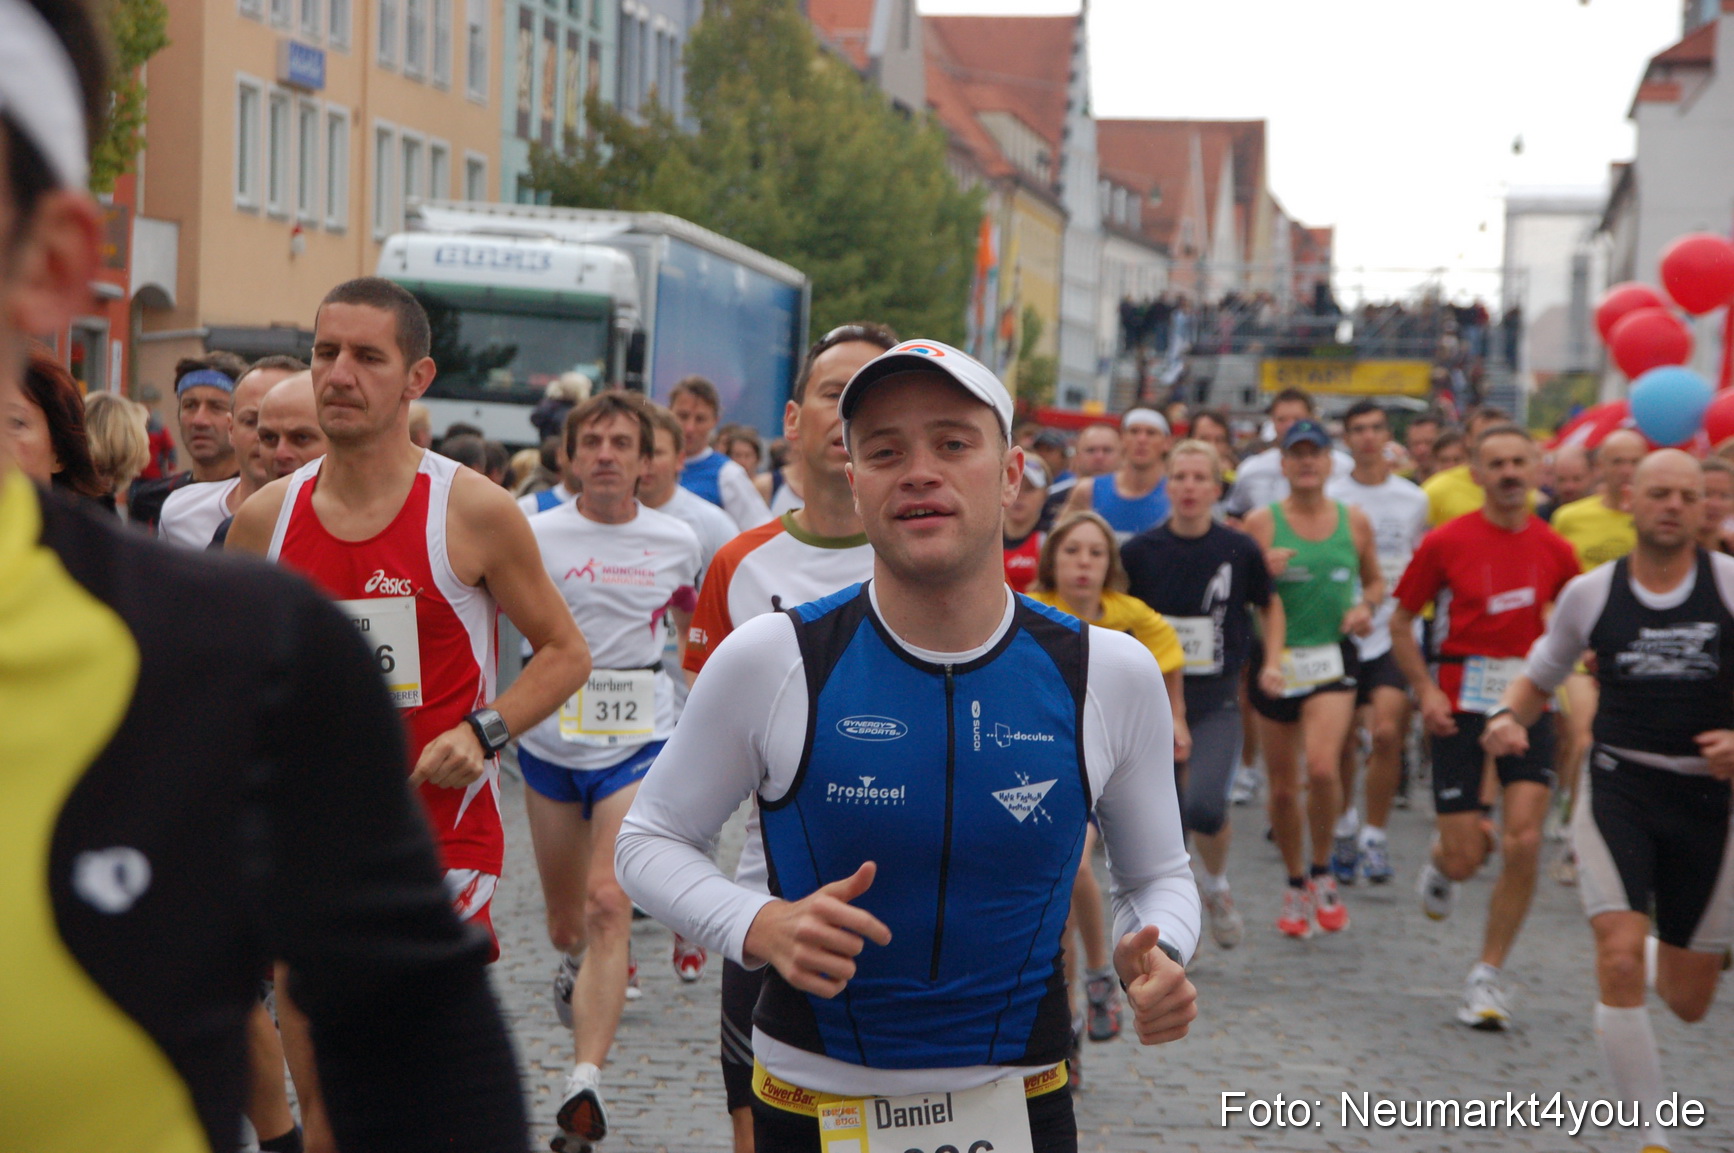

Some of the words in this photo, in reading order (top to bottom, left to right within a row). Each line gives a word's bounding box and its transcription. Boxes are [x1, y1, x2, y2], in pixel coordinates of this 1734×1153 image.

[587, 677, 634, 692] Herbert
[596, 701, 638, 721] 312
[843, 720, 887, 728] SYNERGY
[858, 727, 897, 736] SPORTS
[1013, 731, 1054, 742] doculex
[874, 1092, 953, 1130] Daniel
